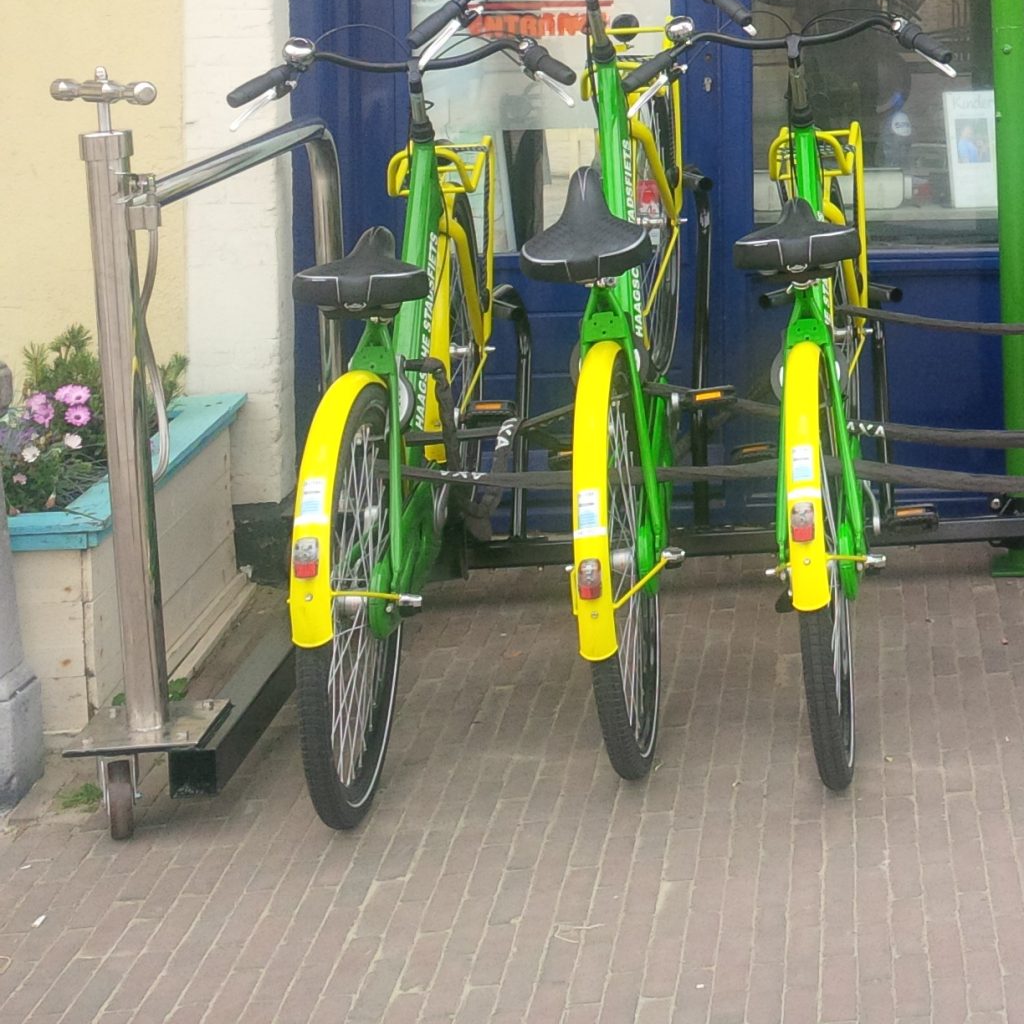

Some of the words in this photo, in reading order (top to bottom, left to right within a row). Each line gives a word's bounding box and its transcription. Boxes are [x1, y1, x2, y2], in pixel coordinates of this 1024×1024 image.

[622, 139, 636, 225] TADSFIETS
[631, 266, 644, 338] HAAGSC
[415, 333, 430, 431] HAAGSHE
